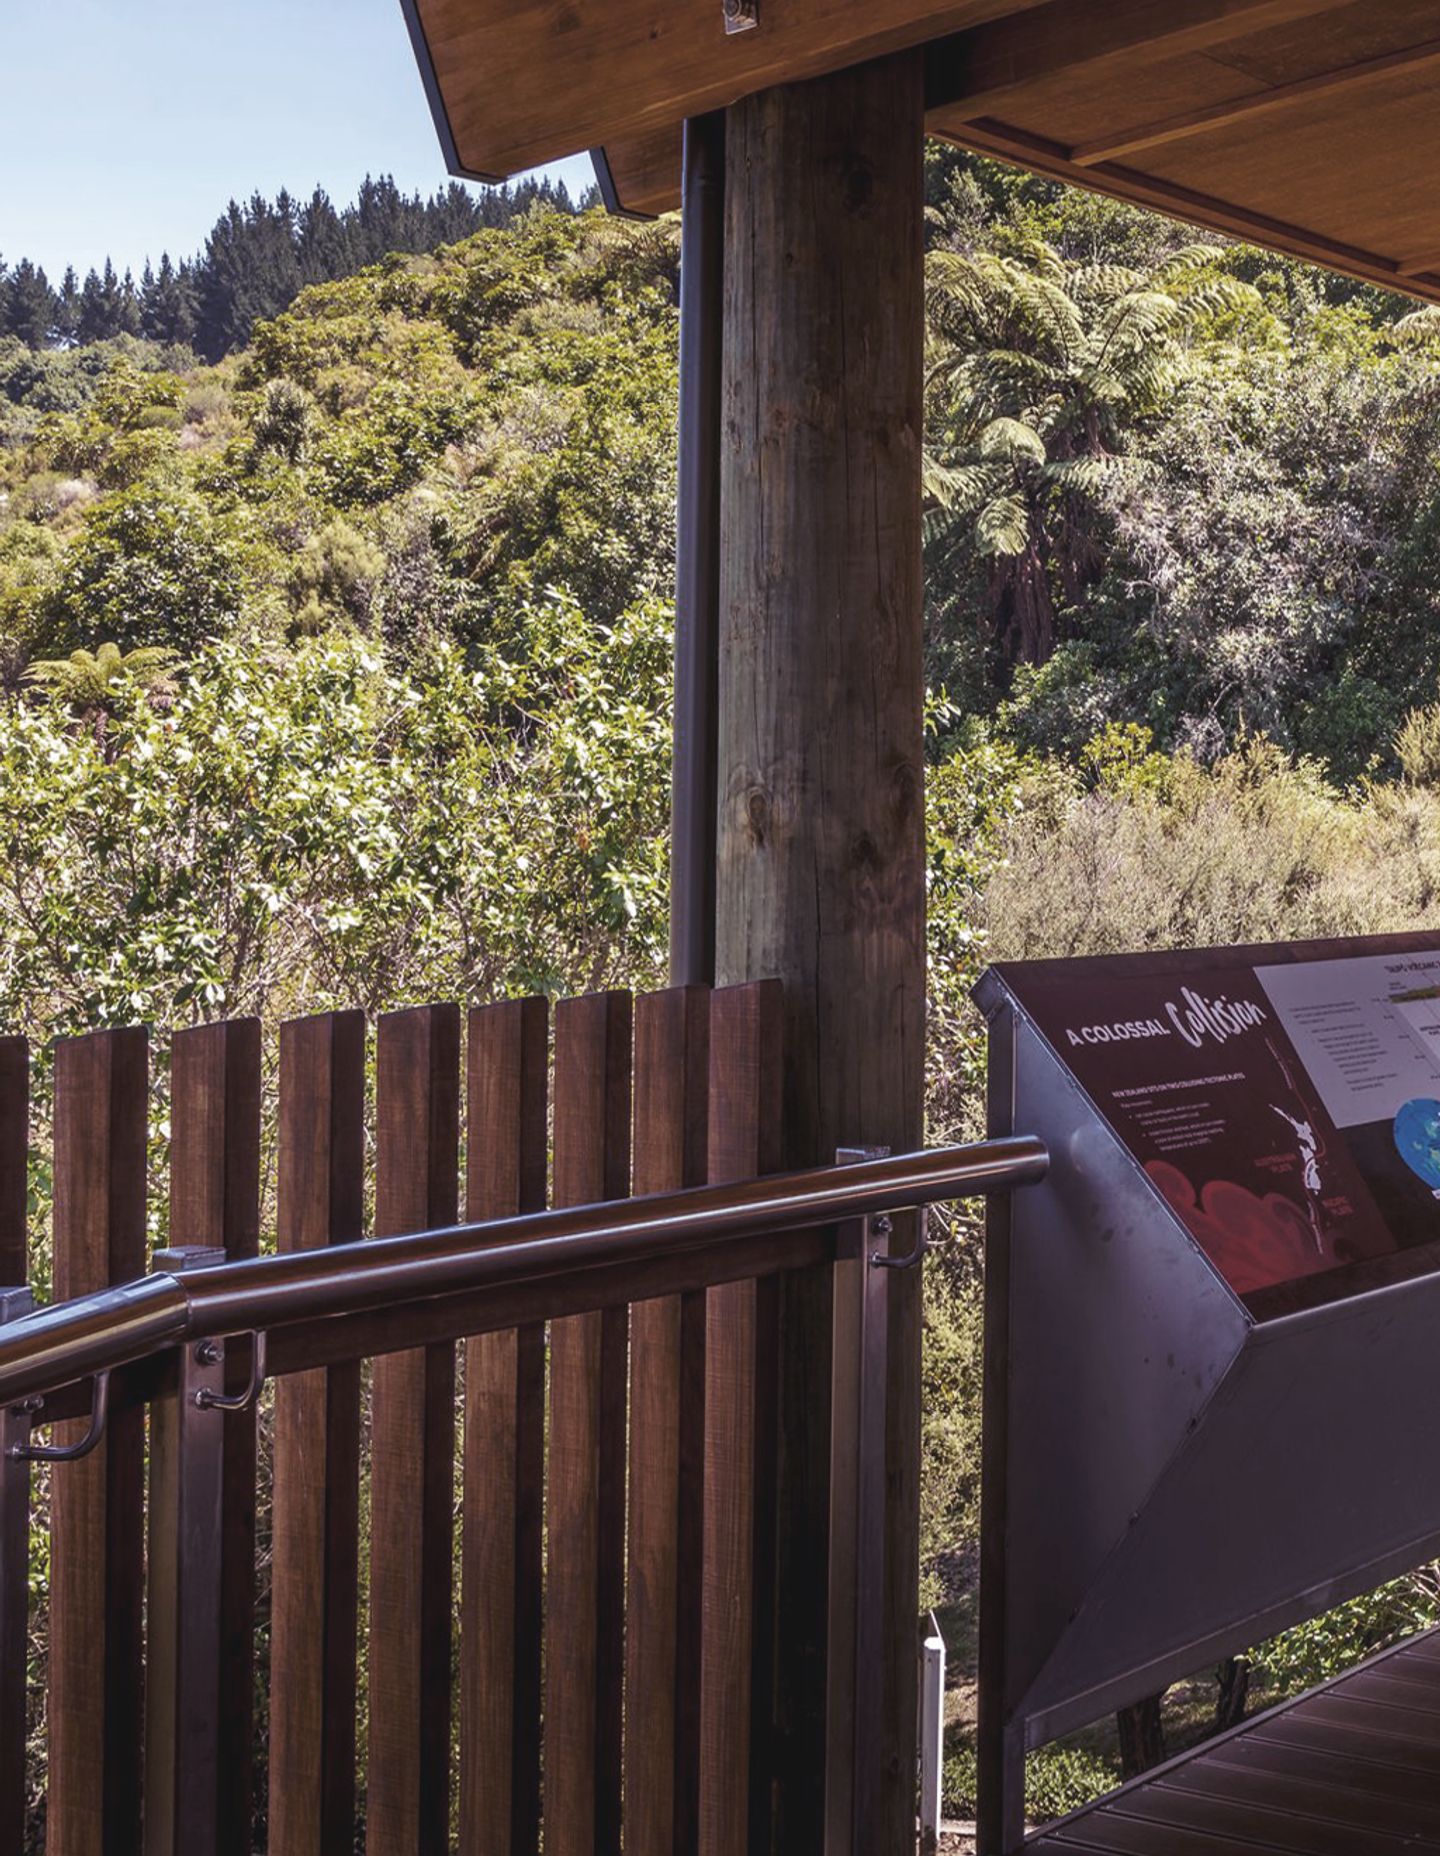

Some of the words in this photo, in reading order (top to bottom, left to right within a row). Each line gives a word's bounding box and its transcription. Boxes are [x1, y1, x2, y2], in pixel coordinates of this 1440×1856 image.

[1065, 1028, 1084, 1046] A
[1081, 1018, 1171, 1045] COLOSSAL
[1165, 986, 1267, 1048] Collision
